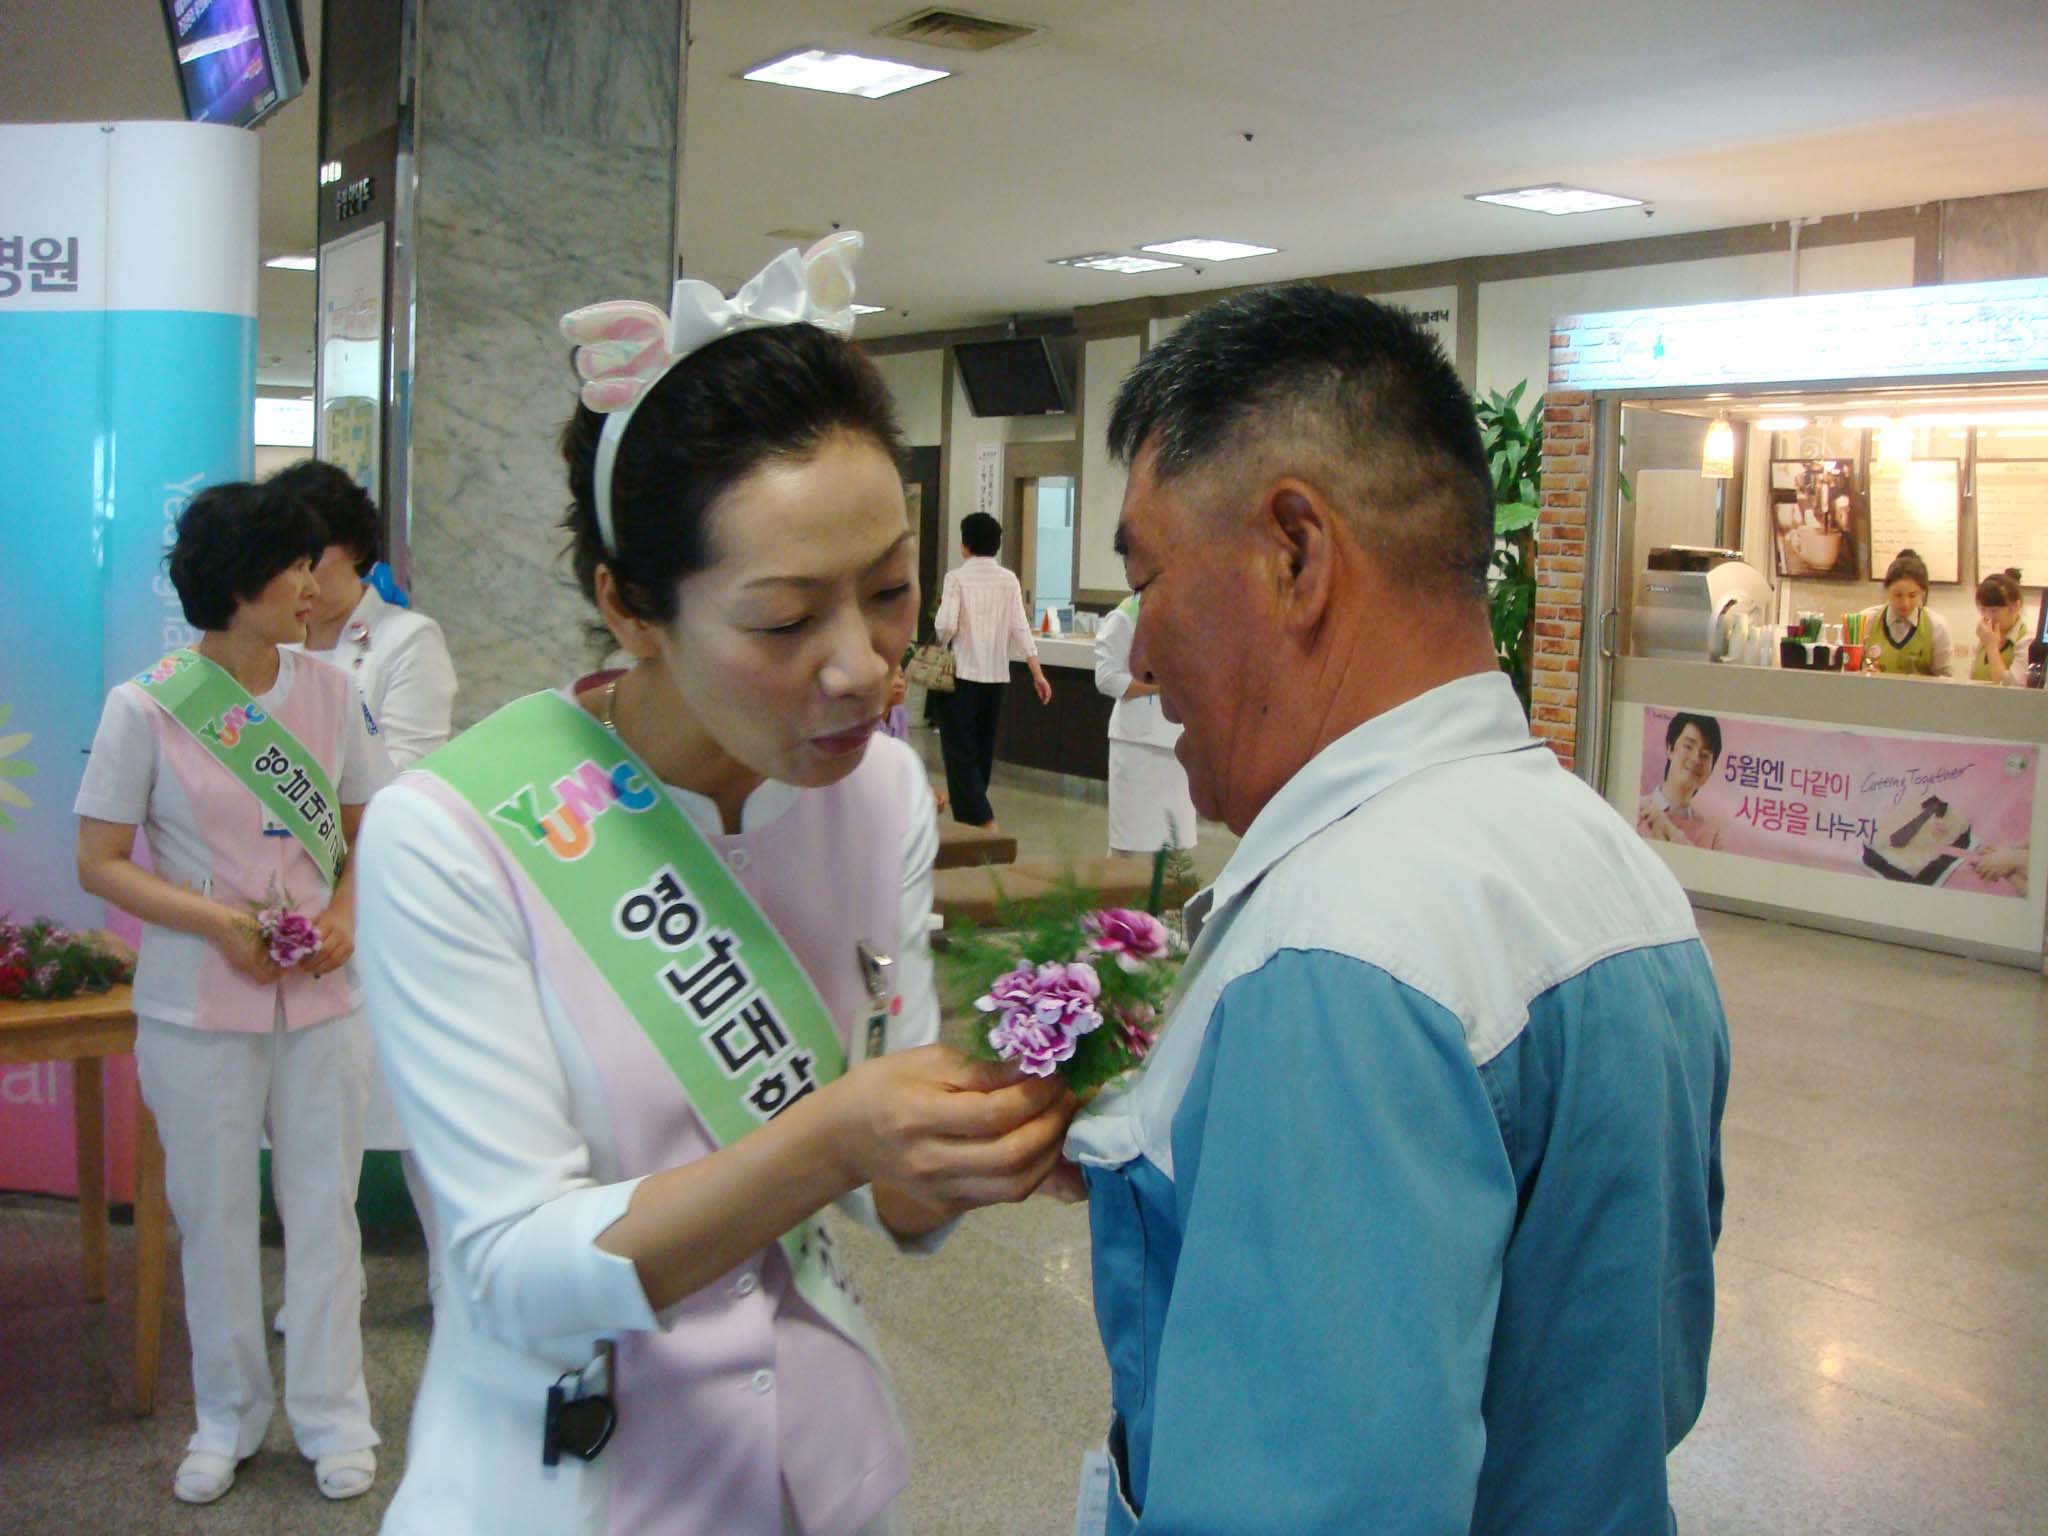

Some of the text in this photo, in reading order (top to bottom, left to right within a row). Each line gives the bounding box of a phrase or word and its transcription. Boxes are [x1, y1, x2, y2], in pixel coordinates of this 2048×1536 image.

[200, 702, 266, 748] YUMC
[1724, 754, 1850, 801] 5월엔 다같이
[488, 758, 658, 860] YUMC
[1735, 795, 1879, 846] 사랑을 나누자
